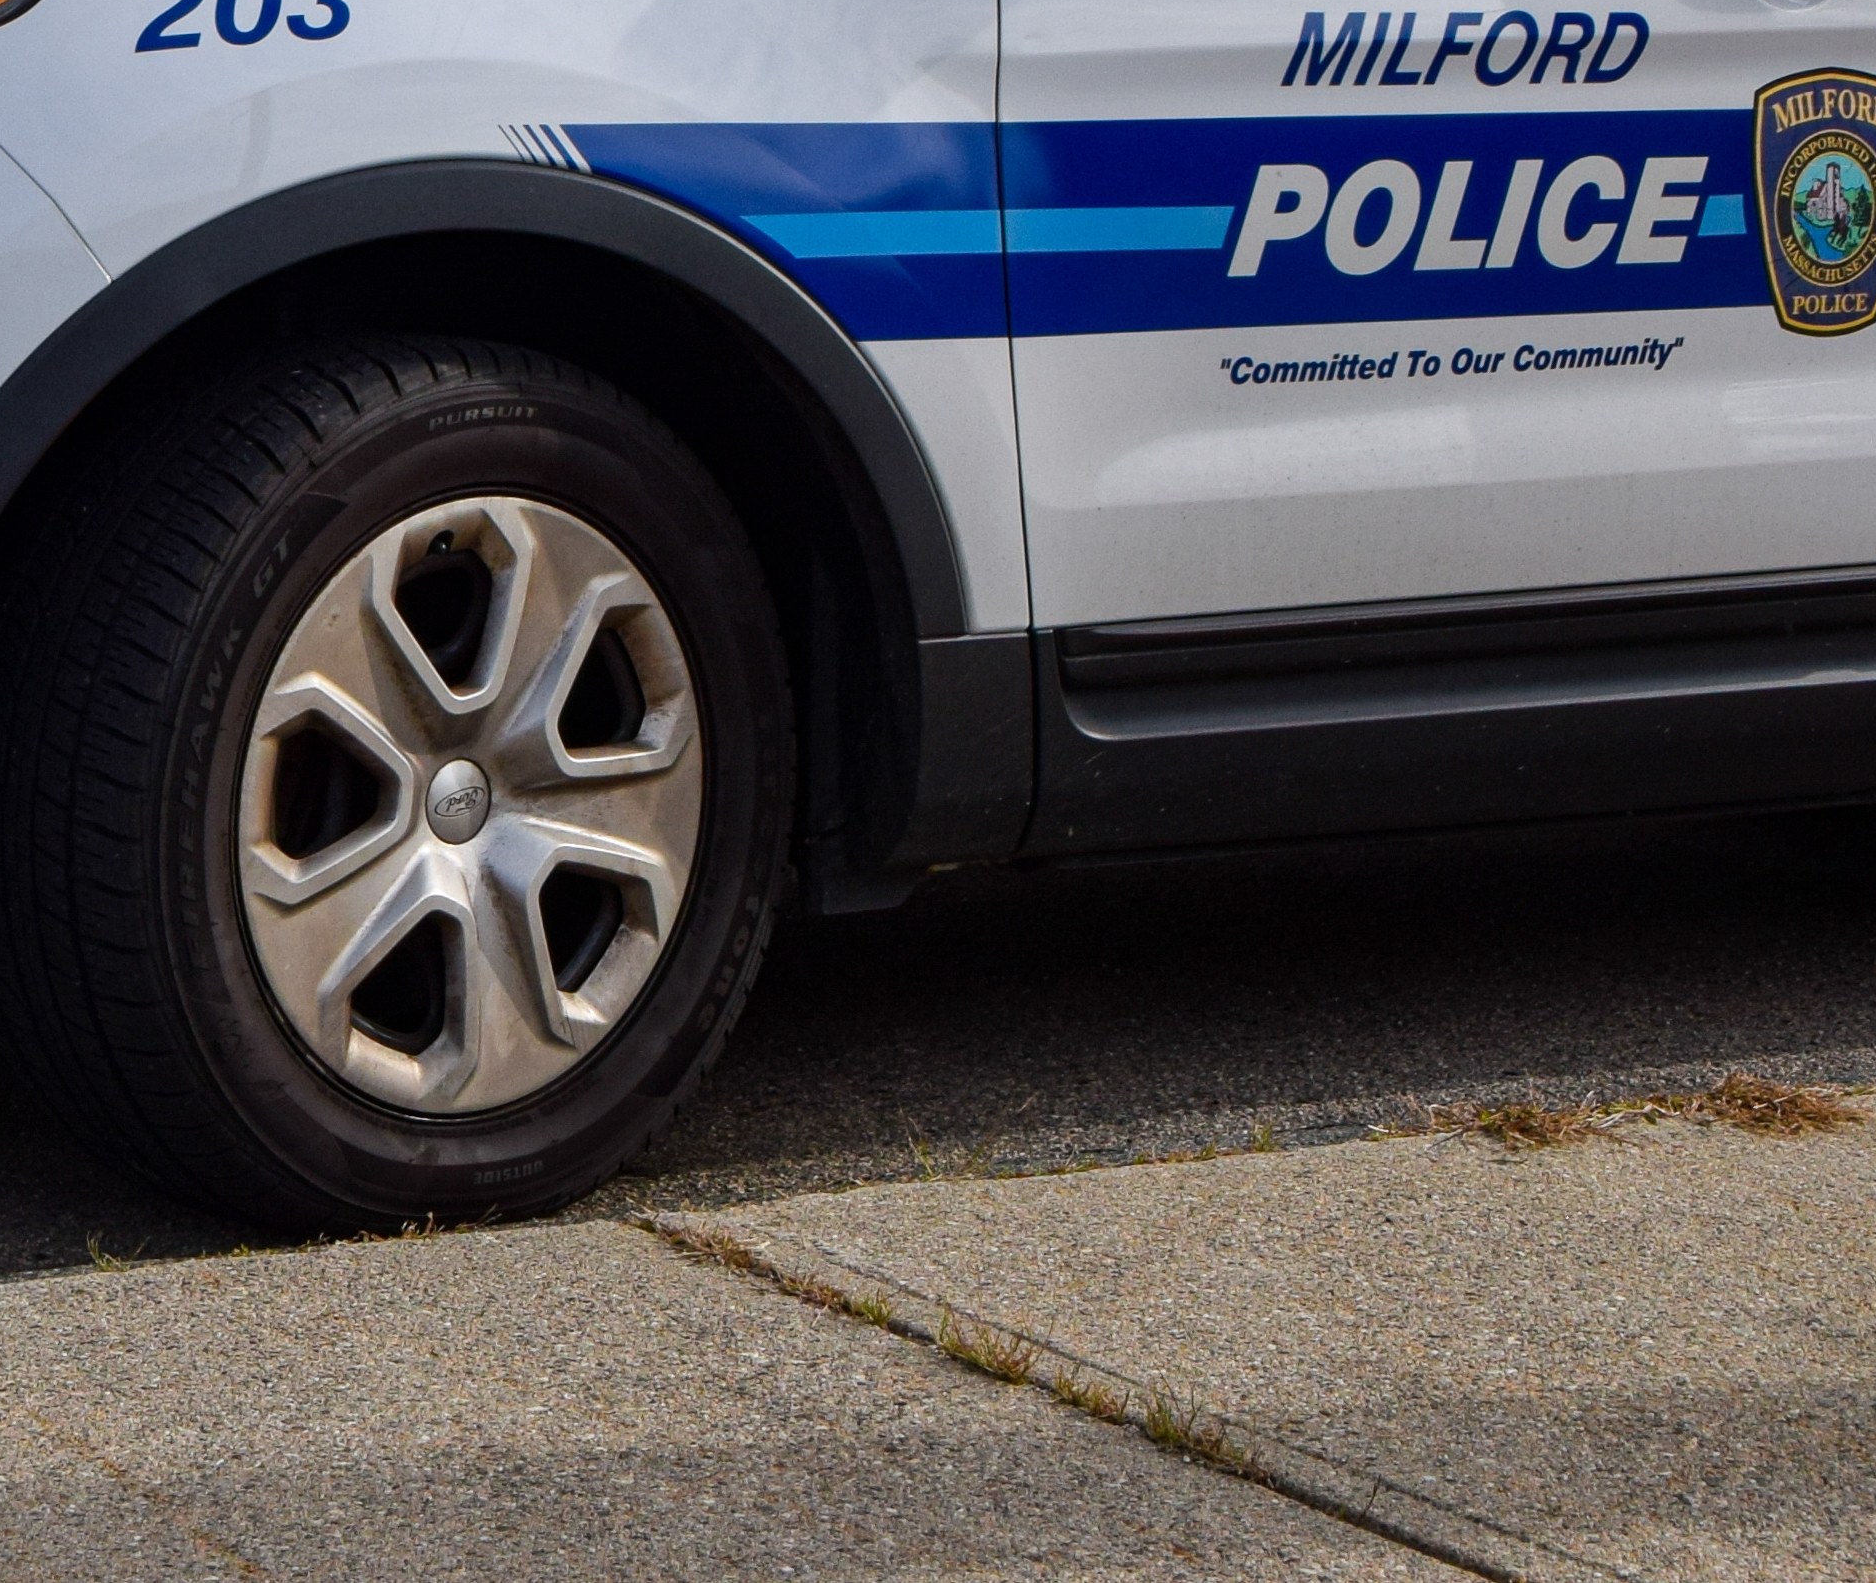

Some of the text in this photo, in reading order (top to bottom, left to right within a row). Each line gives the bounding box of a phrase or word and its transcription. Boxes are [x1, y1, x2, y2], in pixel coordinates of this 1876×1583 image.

[1280, 10, 1650, 87] MILFORD
[1780, 135, 1869, 197] INCORPORATED
[1227, 155, 1710, 278] POLICE
[1792, 293, 1868, 315] POLICE
[1220, 337, 1685, 385] "Committed To Our Community"
[427, 404, 539, 432] PURSUIT
[251, 530, 291, 599] GT
[473, 1159, 545, 1186] OUTSIDE
